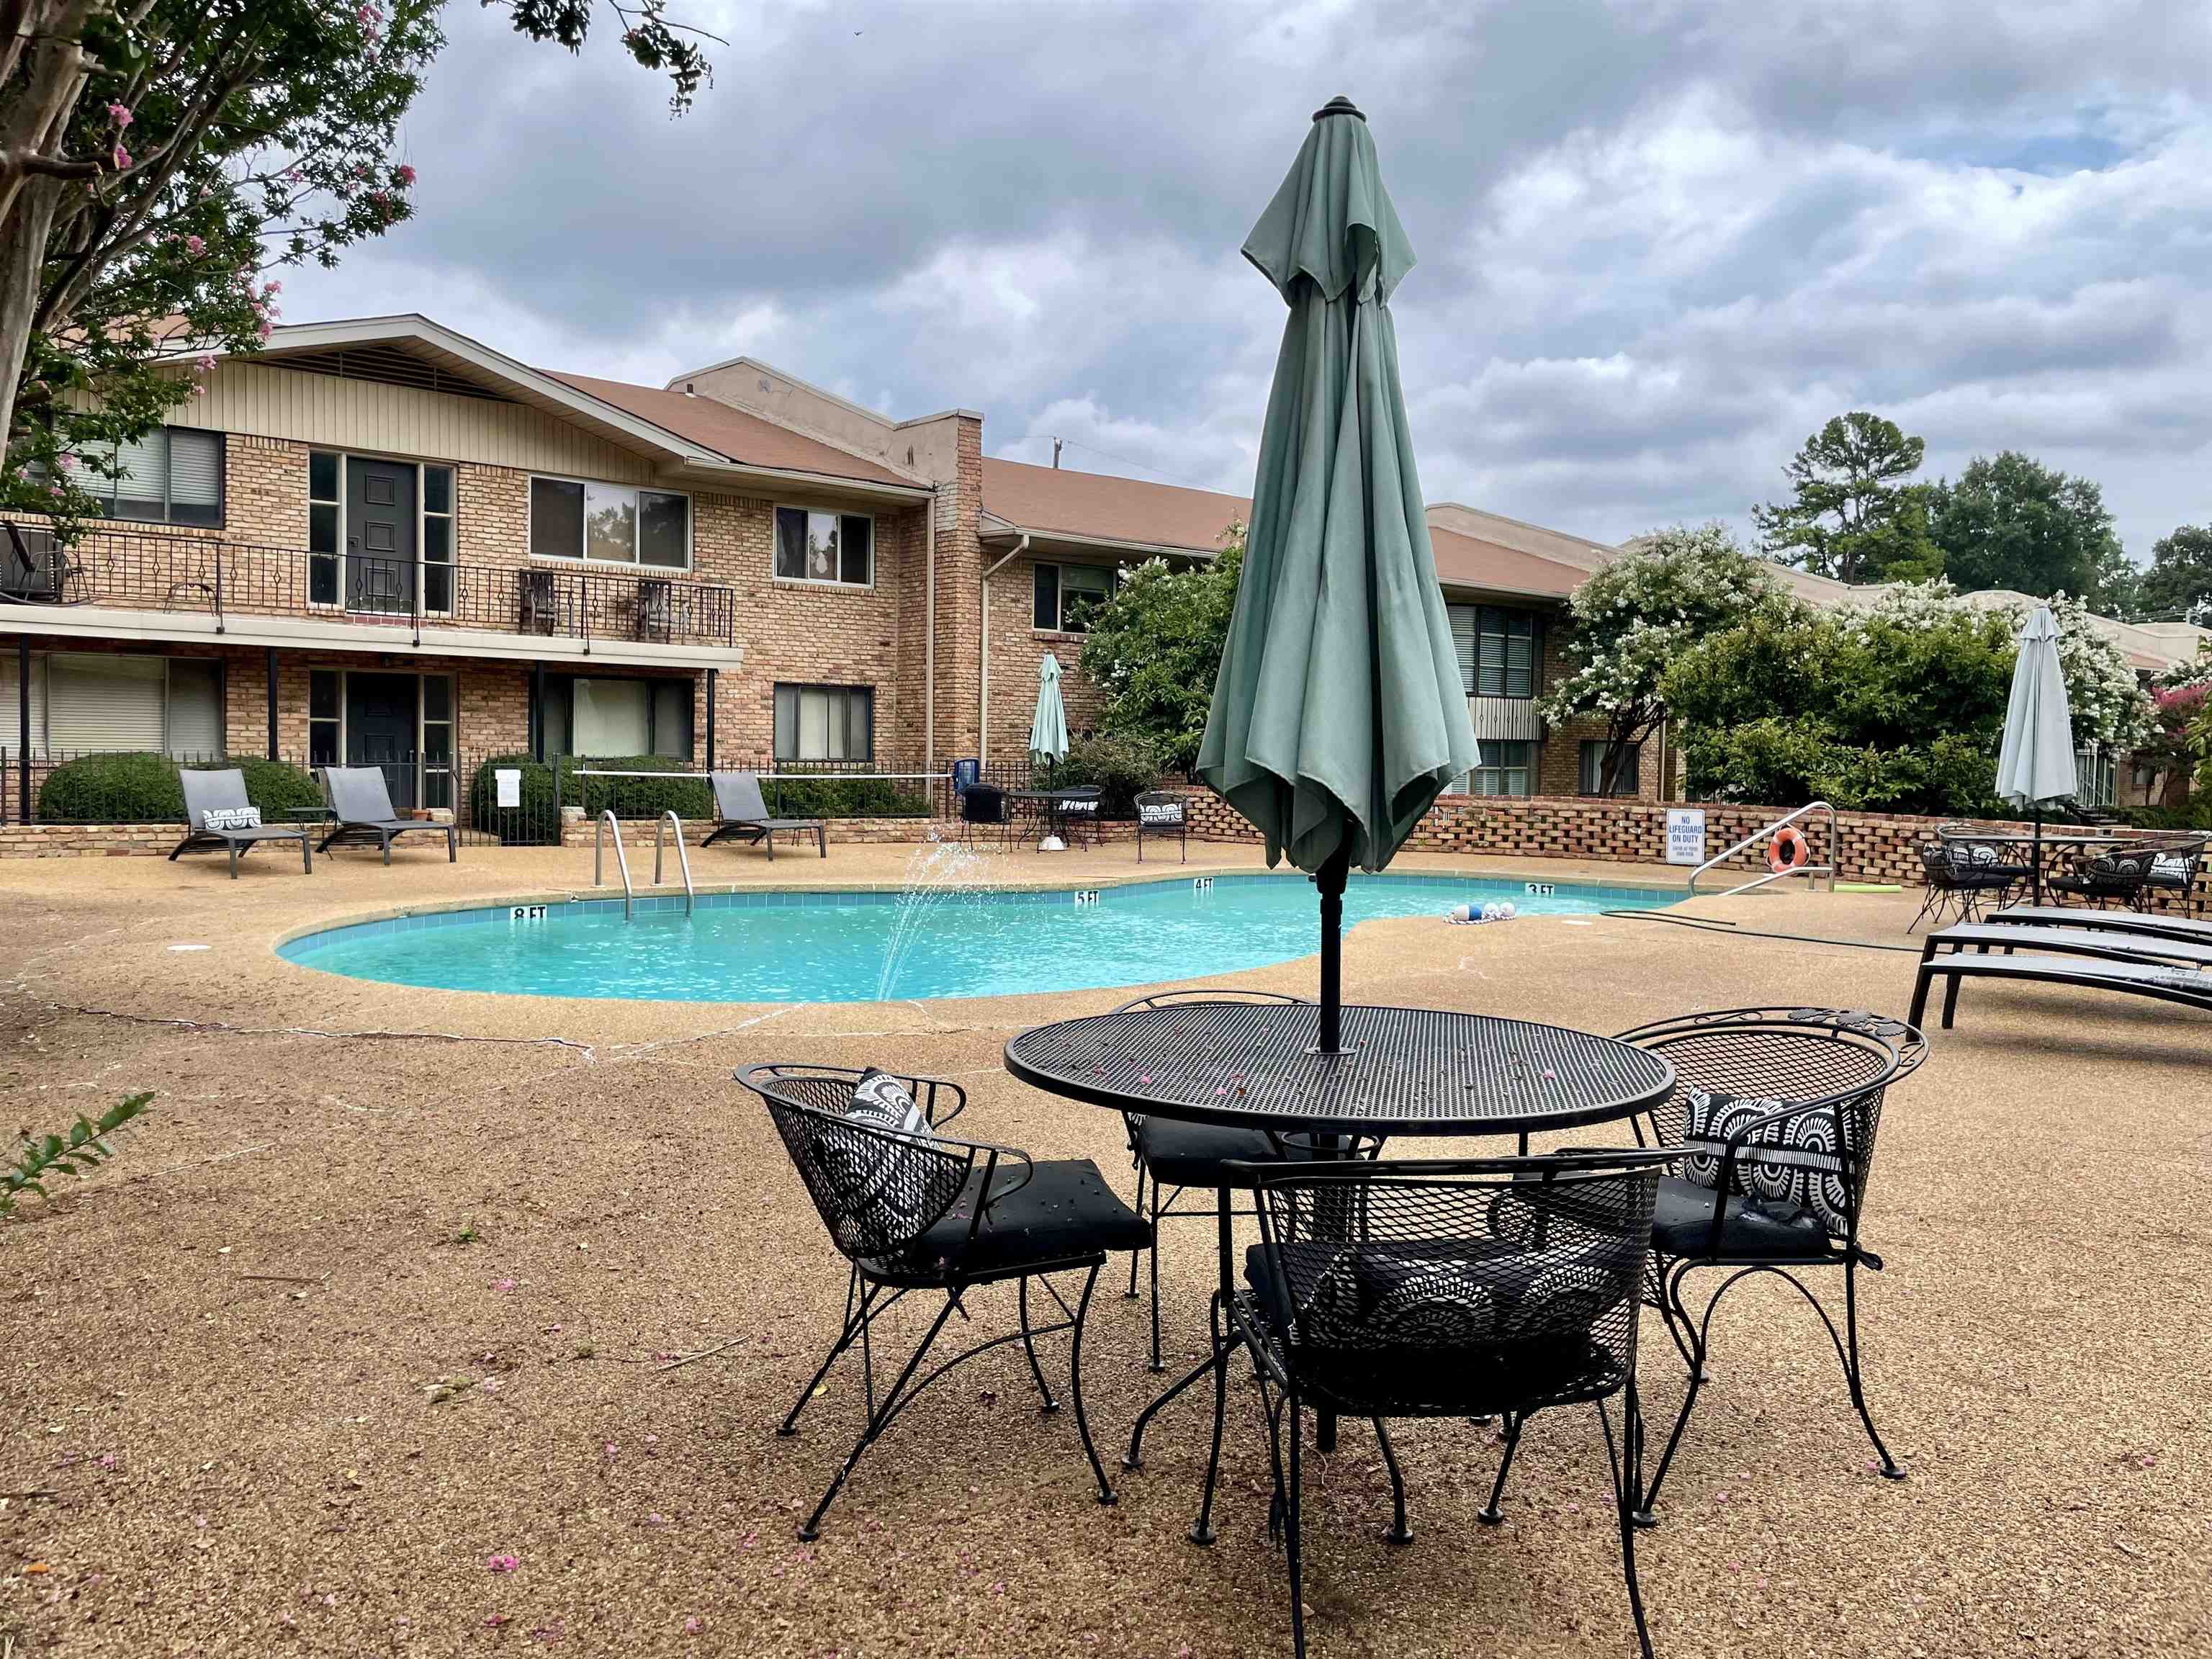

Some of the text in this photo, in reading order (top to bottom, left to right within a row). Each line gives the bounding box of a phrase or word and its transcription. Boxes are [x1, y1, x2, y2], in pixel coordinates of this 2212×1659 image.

[1681, 816, 1690, 824] NO
[1669, 825, 1702, 834] LIFEGUARD
[1204, 878, 1213, 888] FT
[1088, 891, 1098, 904] FT
[529, 906, 546, 919] FT
